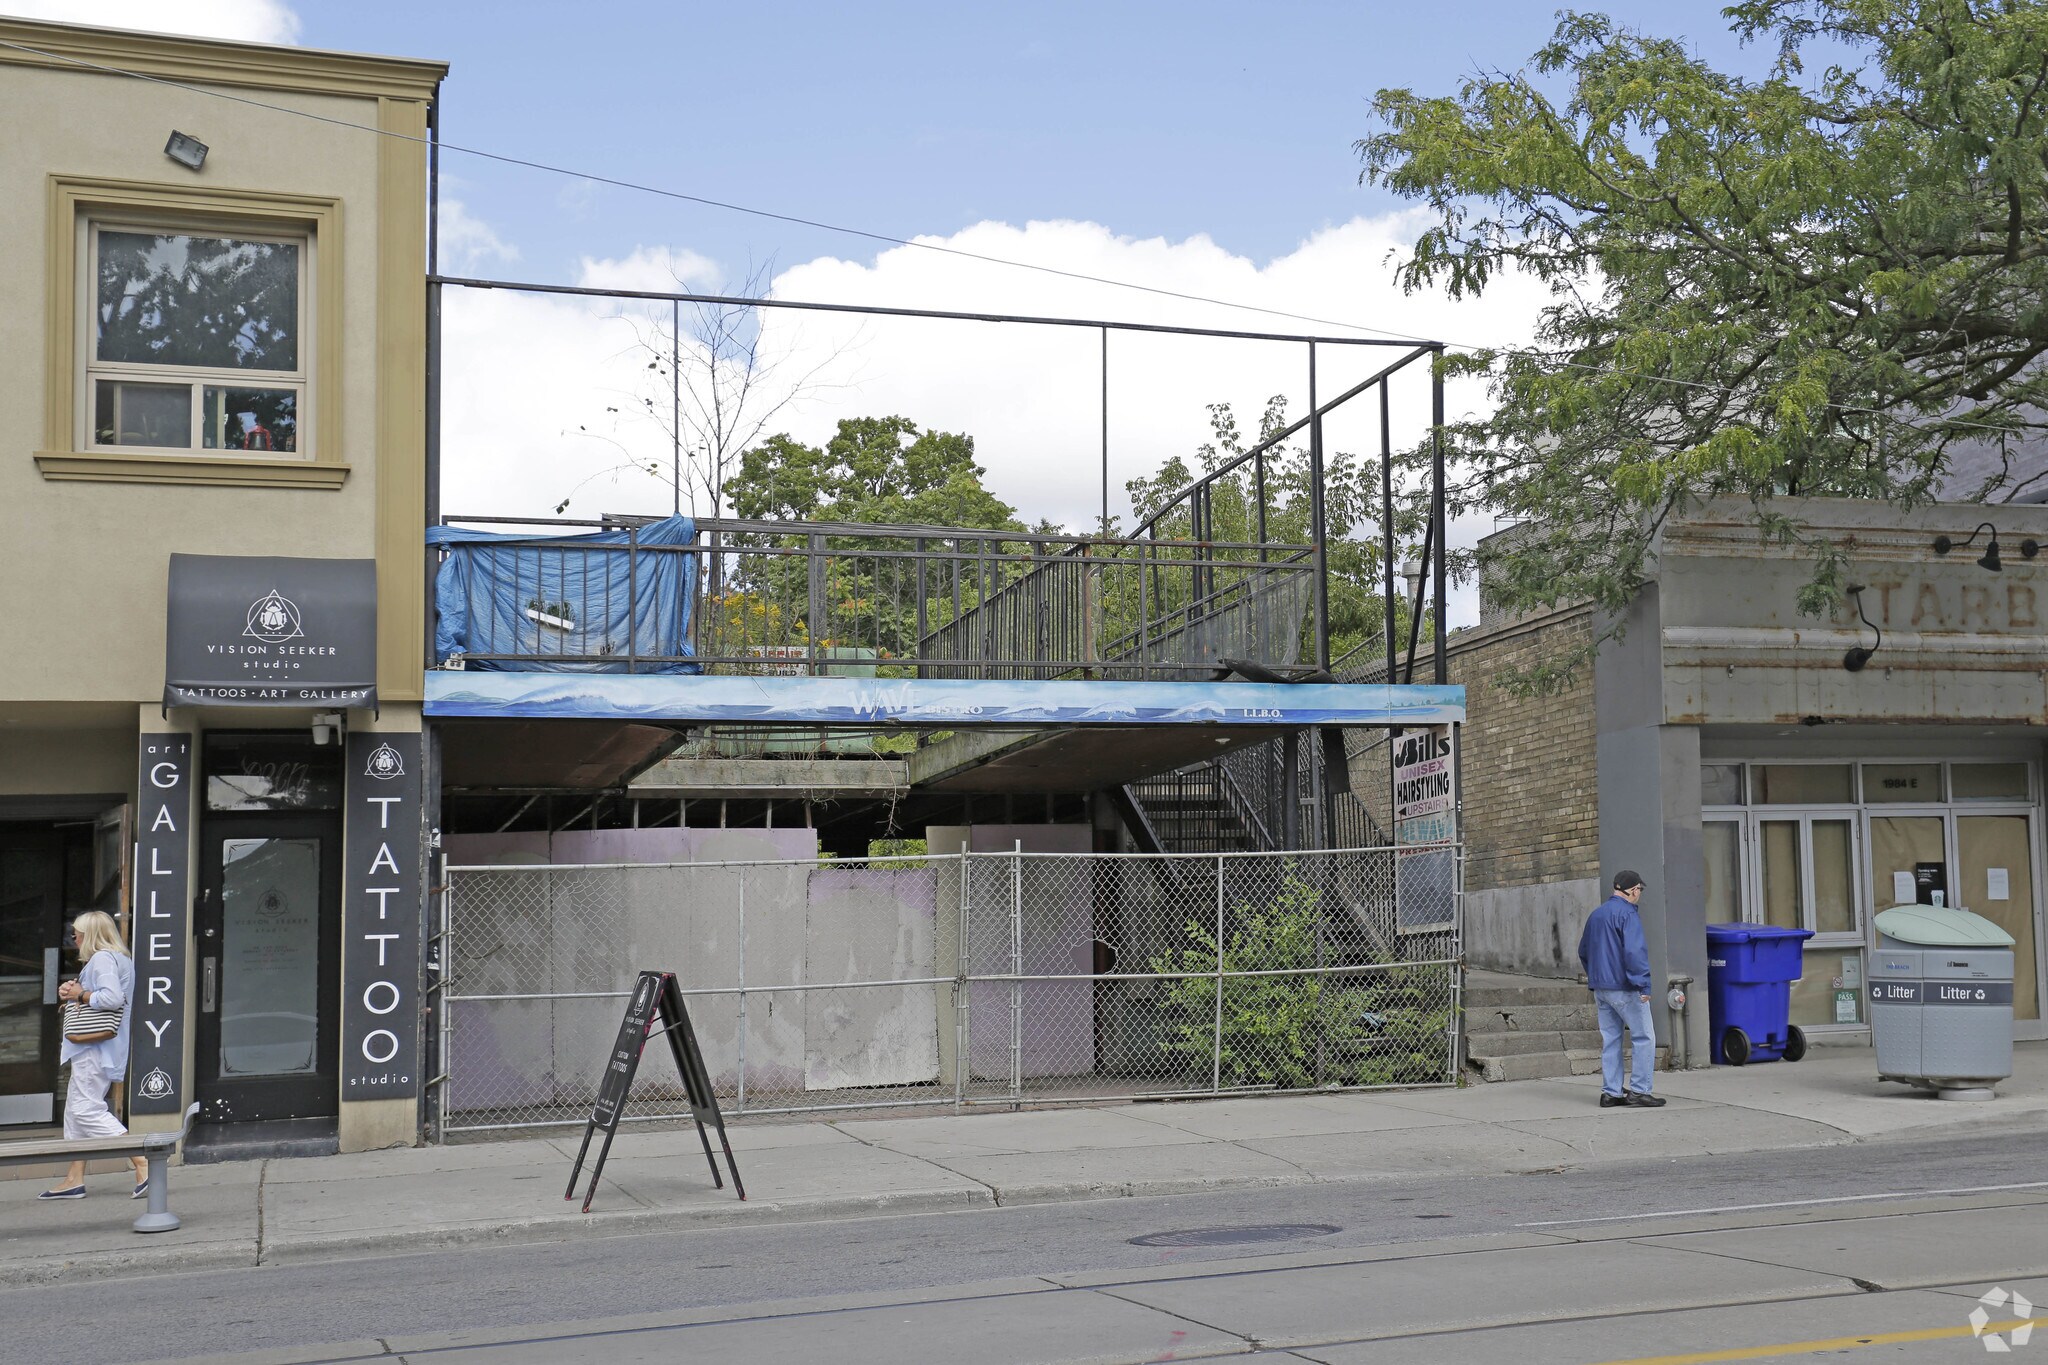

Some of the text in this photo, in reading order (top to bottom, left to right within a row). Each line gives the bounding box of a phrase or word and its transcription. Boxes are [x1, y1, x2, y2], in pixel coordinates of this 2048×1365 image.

[208, 645, 336, 656] VISION SEEKER
[243, 660, 300, 669] studio
[178, 688, 369, 699] TATTOOS ART GALLERY
[849, 681, 921, 720] WAVE
[148, 743, 186, 754] art
[1401, 759, 1445, 780] UNISEX
[1397, 771, 1450, 806] HAIRSTYLING
[1882, 778, 1918, 789] 1984 E
[145, 762, 180, 1048] GALLERY
[361, 797, 401, 1063] TATTOO
[1838, 993, 1854, 1001] PASS
[1887, 984, 1915, 999] Litter
[1940, 986, 1972, 1000] Litter
[611, 1060, 628, 1073] TATTOOS
[350, 1073, 409, 1086] studio
